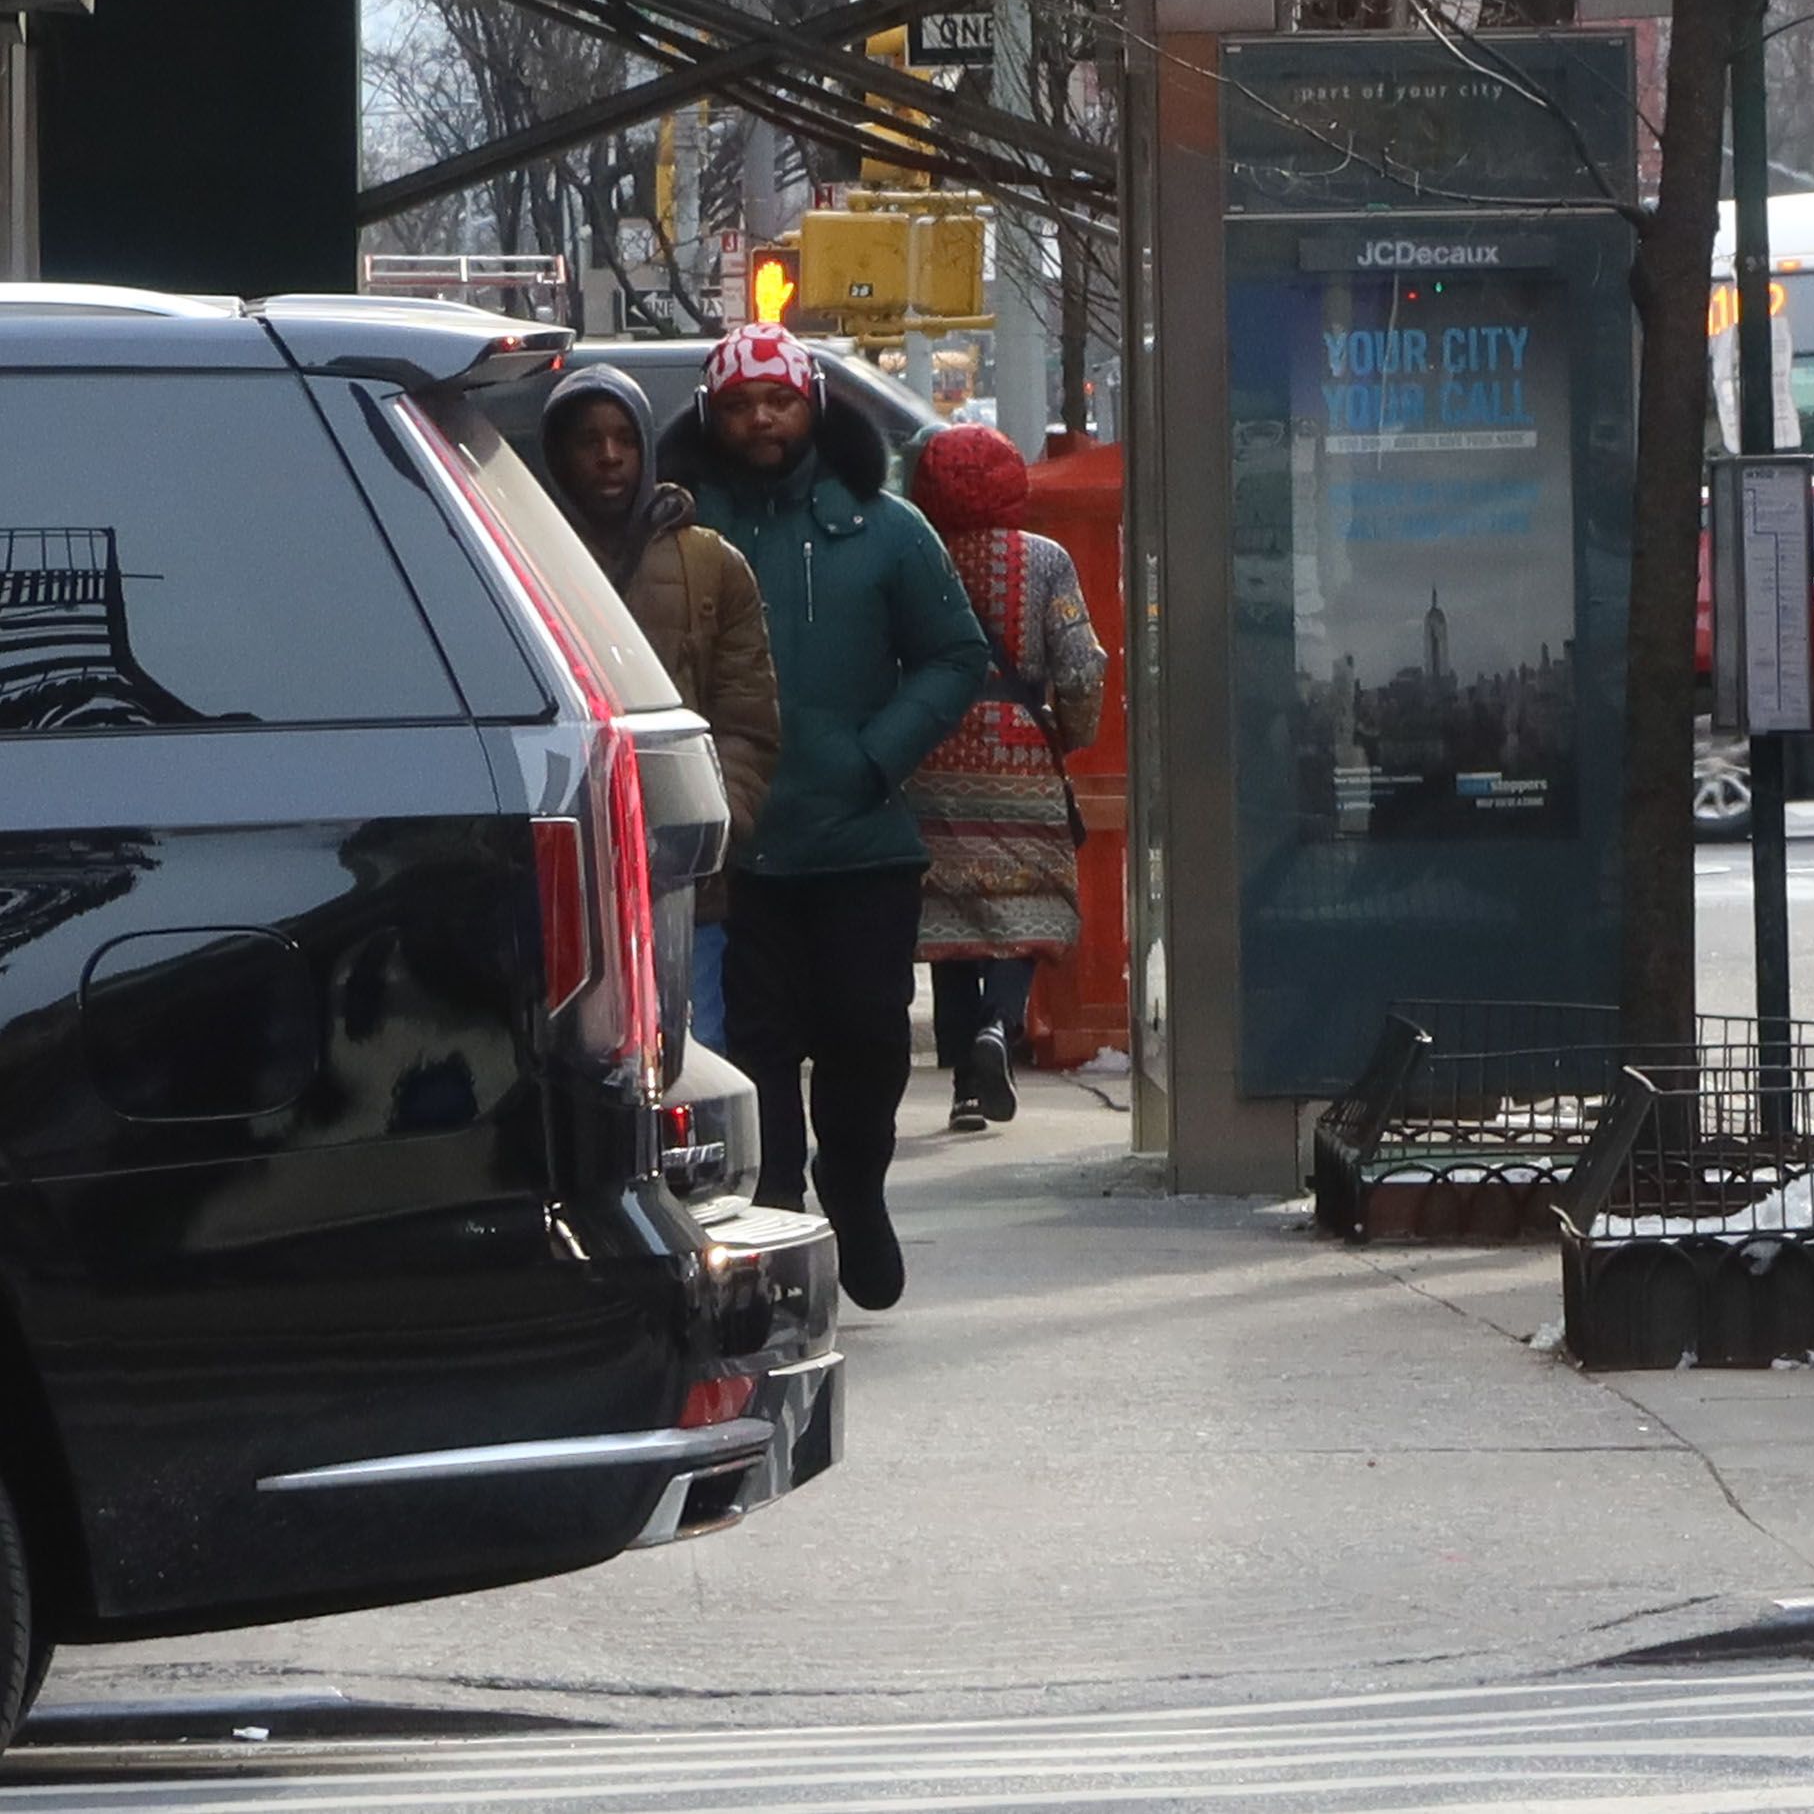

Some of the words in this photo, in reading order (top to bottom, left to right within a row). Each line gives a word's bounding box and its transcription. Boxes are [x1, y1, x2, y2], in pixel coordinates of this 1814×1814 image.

[1301, 84, 1350, 102] part
[1362, 82, 1384, 100] of
[1397, 84, 1447, 106] your
[1459, 83, 1504, 102] city
[1357, 241, 1500, 267] JCDecaux
[1322, 328, 1428, 378] YOUR
[1442, 326, 1529, 374] CITY
[1321, 383, 1425, 432] YOUR
